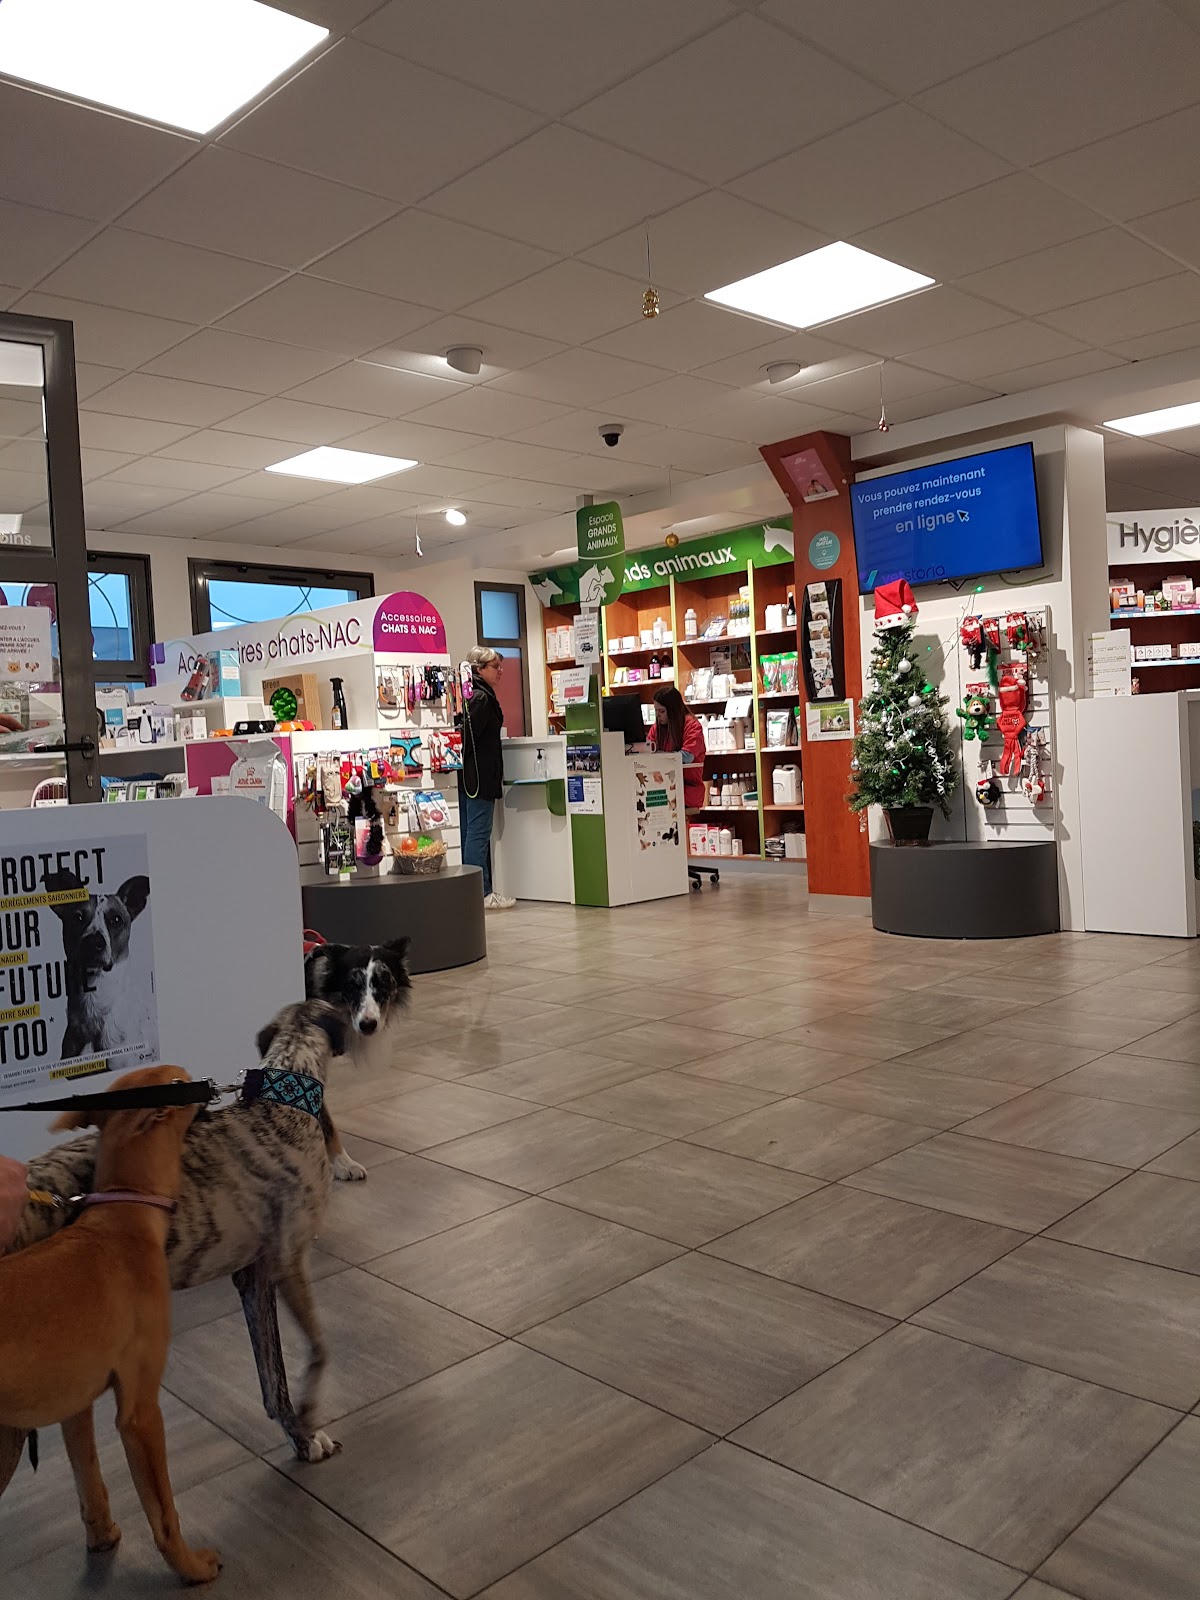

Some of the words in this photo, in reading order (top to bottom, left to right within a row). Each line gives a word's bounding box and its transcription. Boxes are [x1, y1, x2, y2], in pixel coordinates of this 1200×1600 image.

[857, 491, 883, 504] Vous
[884, 483, 921, 501] pouvez
[922, 467, 986, 490] maintenant
[872, 499, 913, 520] prendre
[914, 487, 982, 509] rendez-vous
[588, 512, 614, 526] Espace
[895, 519, 914, 534] en
[917, 511, 955, 532] ligne
[587, 523, 617, 539] GRANDS
[1120, 517, 1200, 554] Hygiè
[586, 536, 619, 551] ANIMAUX
[653, 546, 737, 576] animaux
[381, 611, 437, 624] Accessoires
[381, 624, 409, 634] CHATS
[410, 625, 417, 635] &
[418, 625, 437, 635] NAC
[268, 618, 362, 659] chats-NAC
[262, 680, 280, 690] Green
[47, 891, 87, 903] SAISONNIERS
[0, 910, 41, 952] UR
[17, 1006, 37, 1017] SANTÉ
